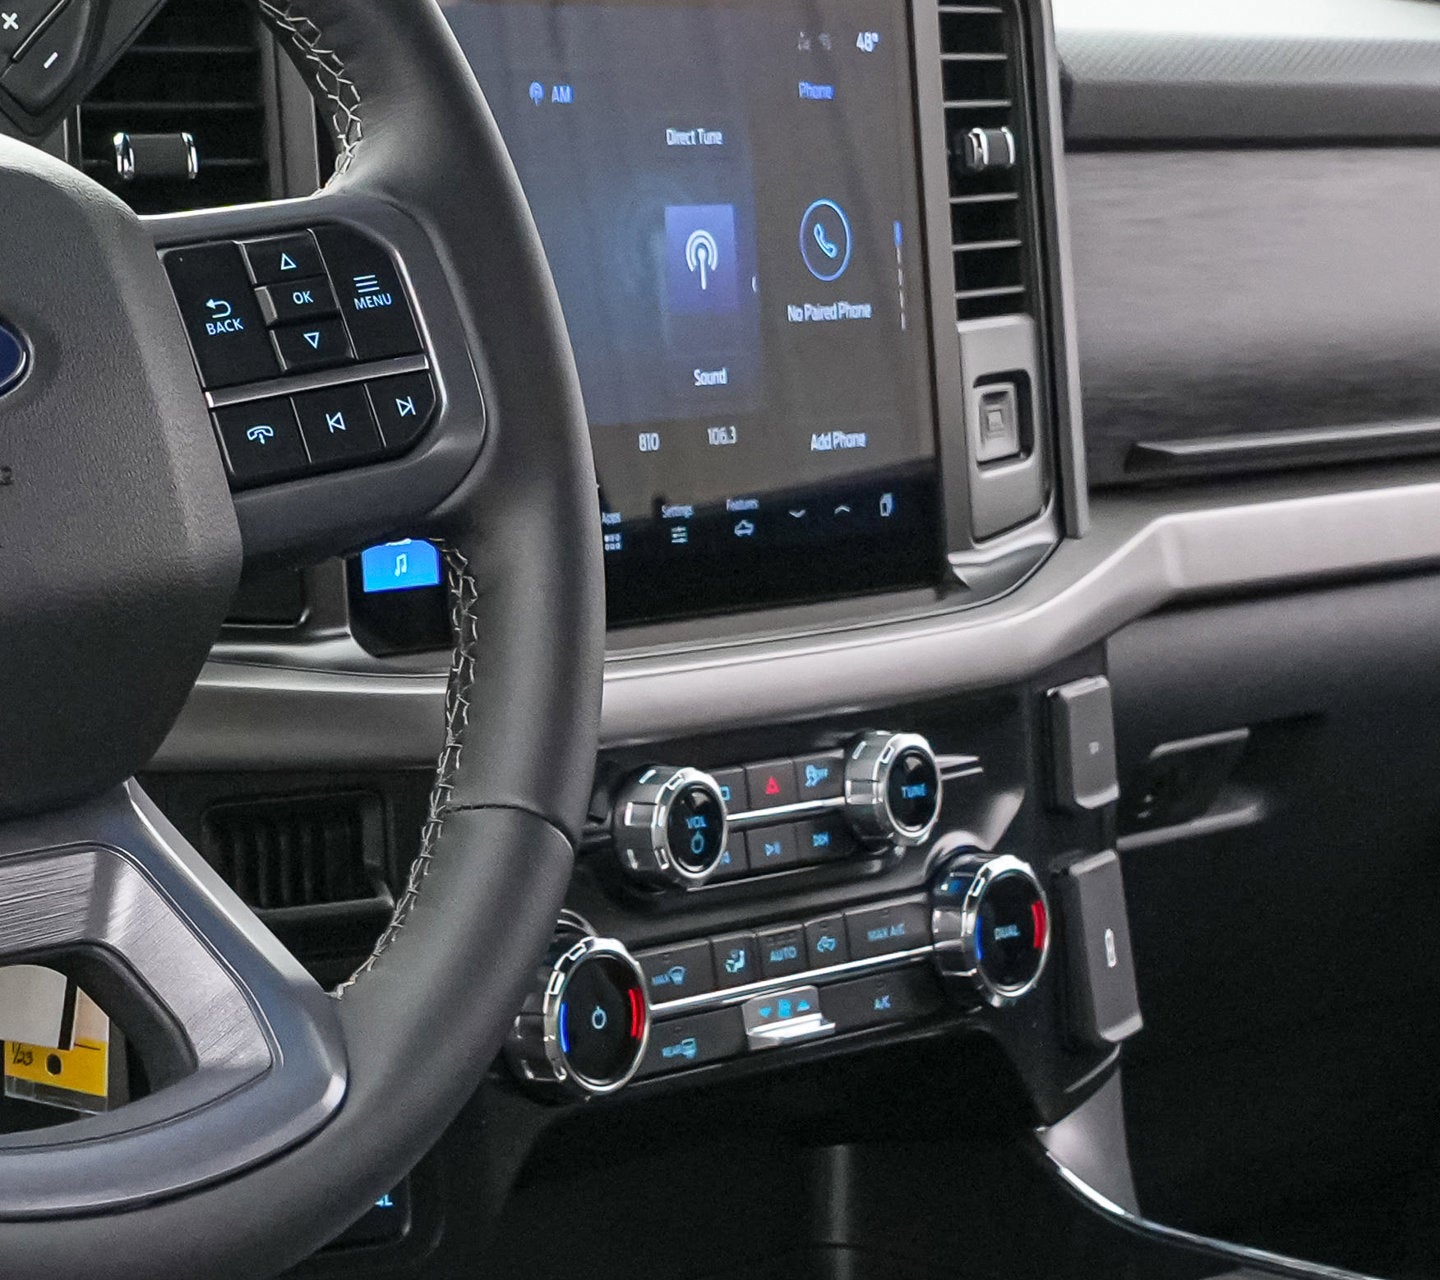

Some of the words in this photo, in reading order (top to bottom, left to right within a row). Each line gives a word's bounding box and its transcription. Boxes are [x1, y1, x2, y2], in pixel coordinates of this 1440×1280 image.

[551, 84, 573, 103] AM
[798, 81, 835, 100] Phone
[665, 128, 696, 146] Direct
[697, 128, 724, 146] Tune
[292, 290, 314, 305] OK
[353, 293, 393, 310] MENU
[787, 304, 803, 322] No
[803, 303, 837, 322] Paired
[837, 301, 872, 320] Phone
[205, 318, 244, 336] BACK
[693, 368, 728, 386] Sound
[638, 432, 660, 452] 810
[707, 426, 738, 445] 106.3
[810, 432, 832, 451] Add
[832, 431, 868, 450] Phone
[685, 815, 707, 829] VOL
[770, 946, 797, 961] AUTO
